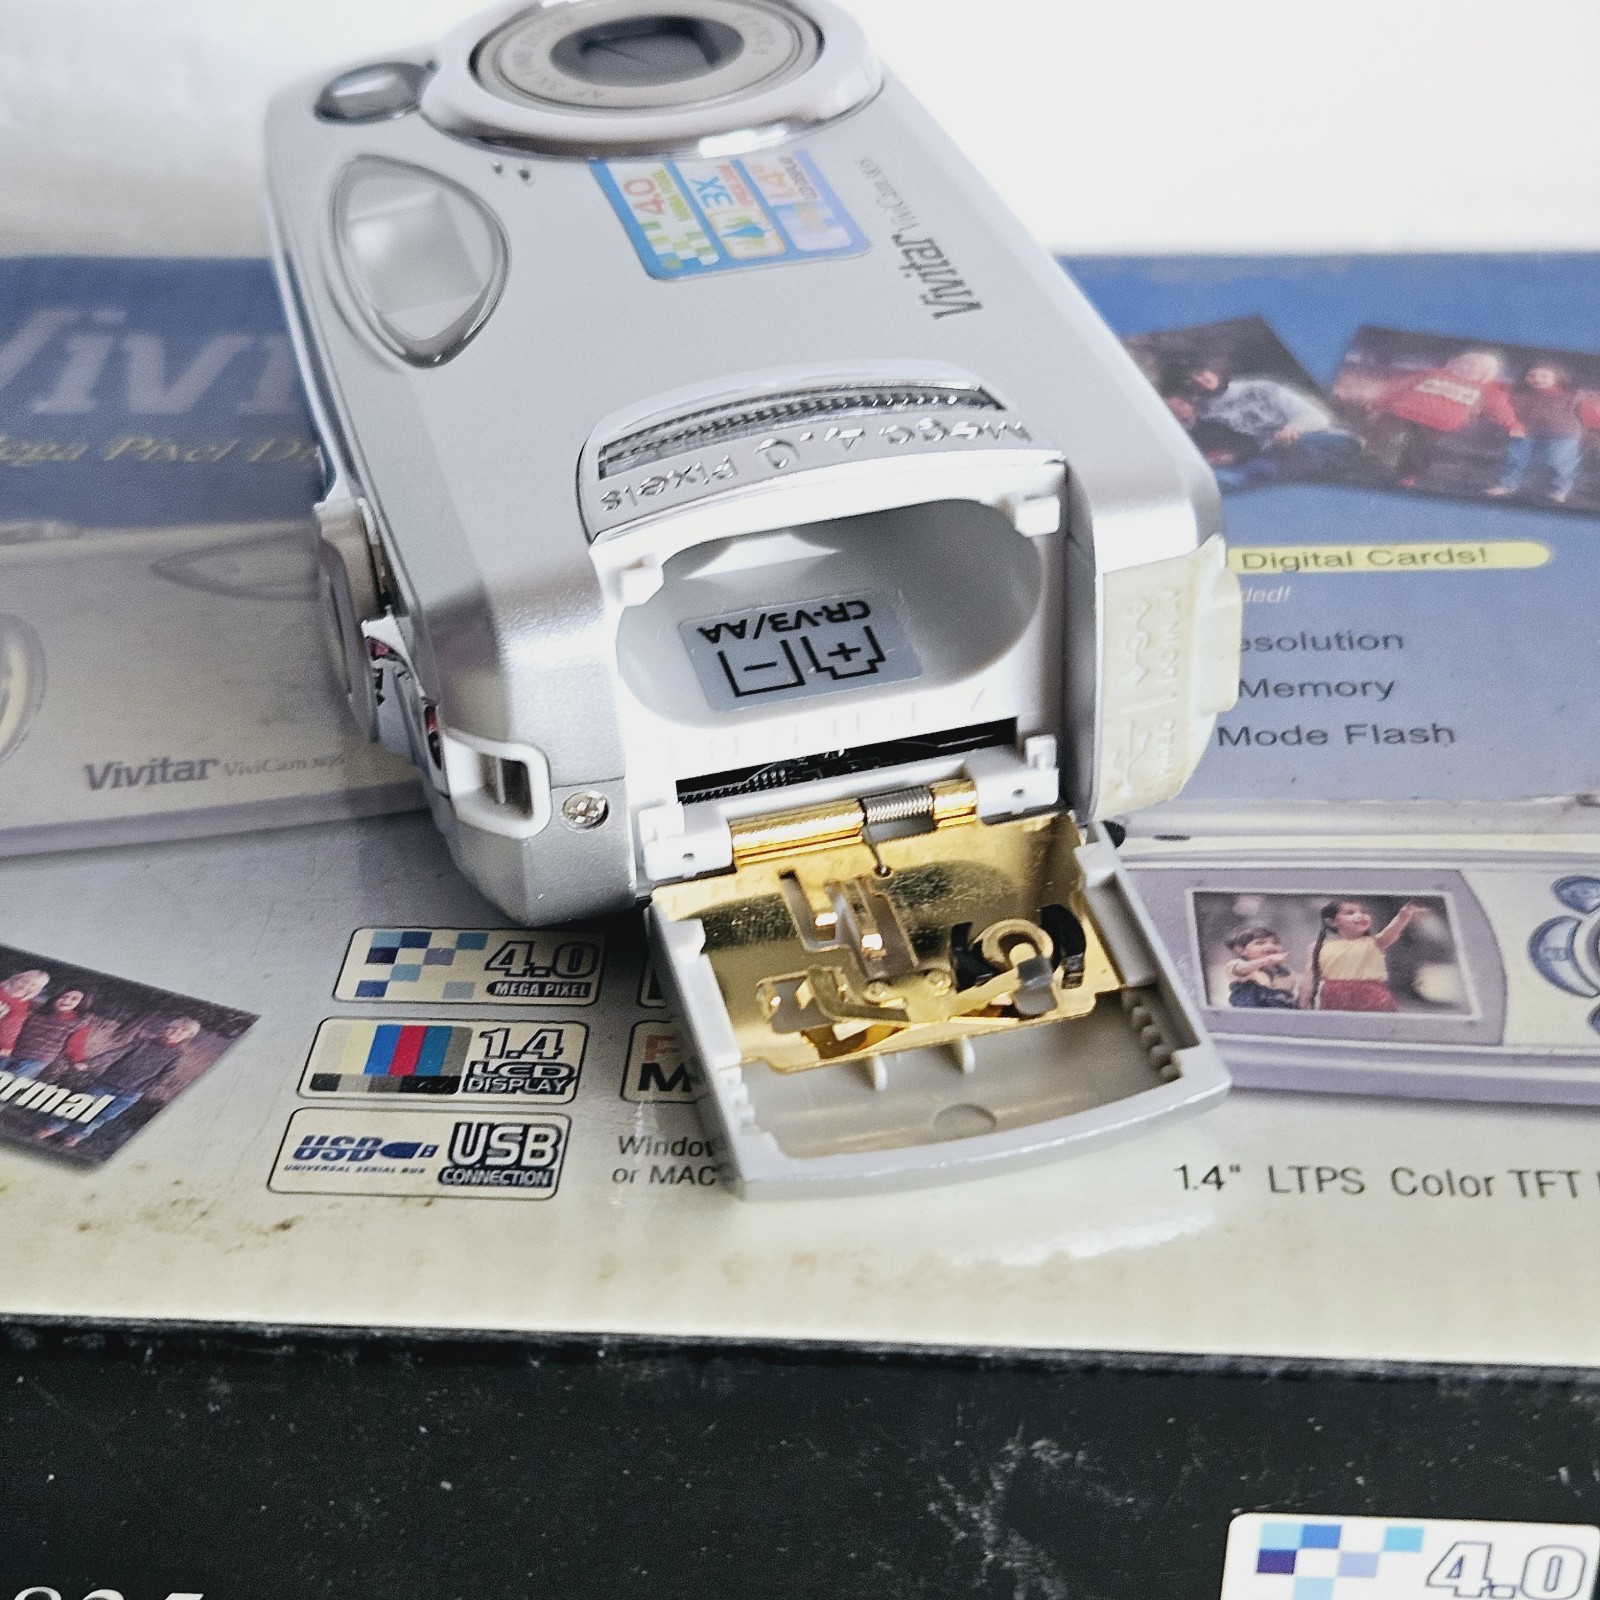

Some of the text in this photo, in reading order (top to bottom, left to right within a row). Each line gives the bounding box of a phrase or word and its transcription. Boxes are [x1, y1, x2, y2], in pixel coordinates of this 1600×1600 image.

[689, 175, 735, 208] 3X
[891, 233, 983, 320] Vivitar
[878, 417, 1033, 445] Mega
[599, 454, 737, 512] Pixels
[1242, 547, 1488, 573] Digital Cards!
[697, 600, 871, 645] CR-V3/AA
[1238, 677, 1396, 702] Memory
[1217, 722, 1455, 747] Mode Flash
[84, 756, 220, 791] Vivitar
[484, 941, 597, 979] 4.0
[494, 981, 588, 997] MEGA PIXEL
[479, 1027, 564, 1060] 1.4
[469, 1061, 577, 1079] LCD
[463, 1076, 570, 1094] DISPLAY
[292, 1135, 386, 1162] USB
[449, 1122, 562, 1168] USB
[284, 1164, 350, 1173] UNIVERSAL
[441, 1167, 552, 1187] CONNECTION
[612, 1165, 717, 1187] or MAC
[1267, 1164, 1367, 1196] LTPS
[1390, 1166, 1496, 1198] Color
[1507, 1168, 1582, 1200] TFT
[1426, 1541, 1587, 1600] 4.0
